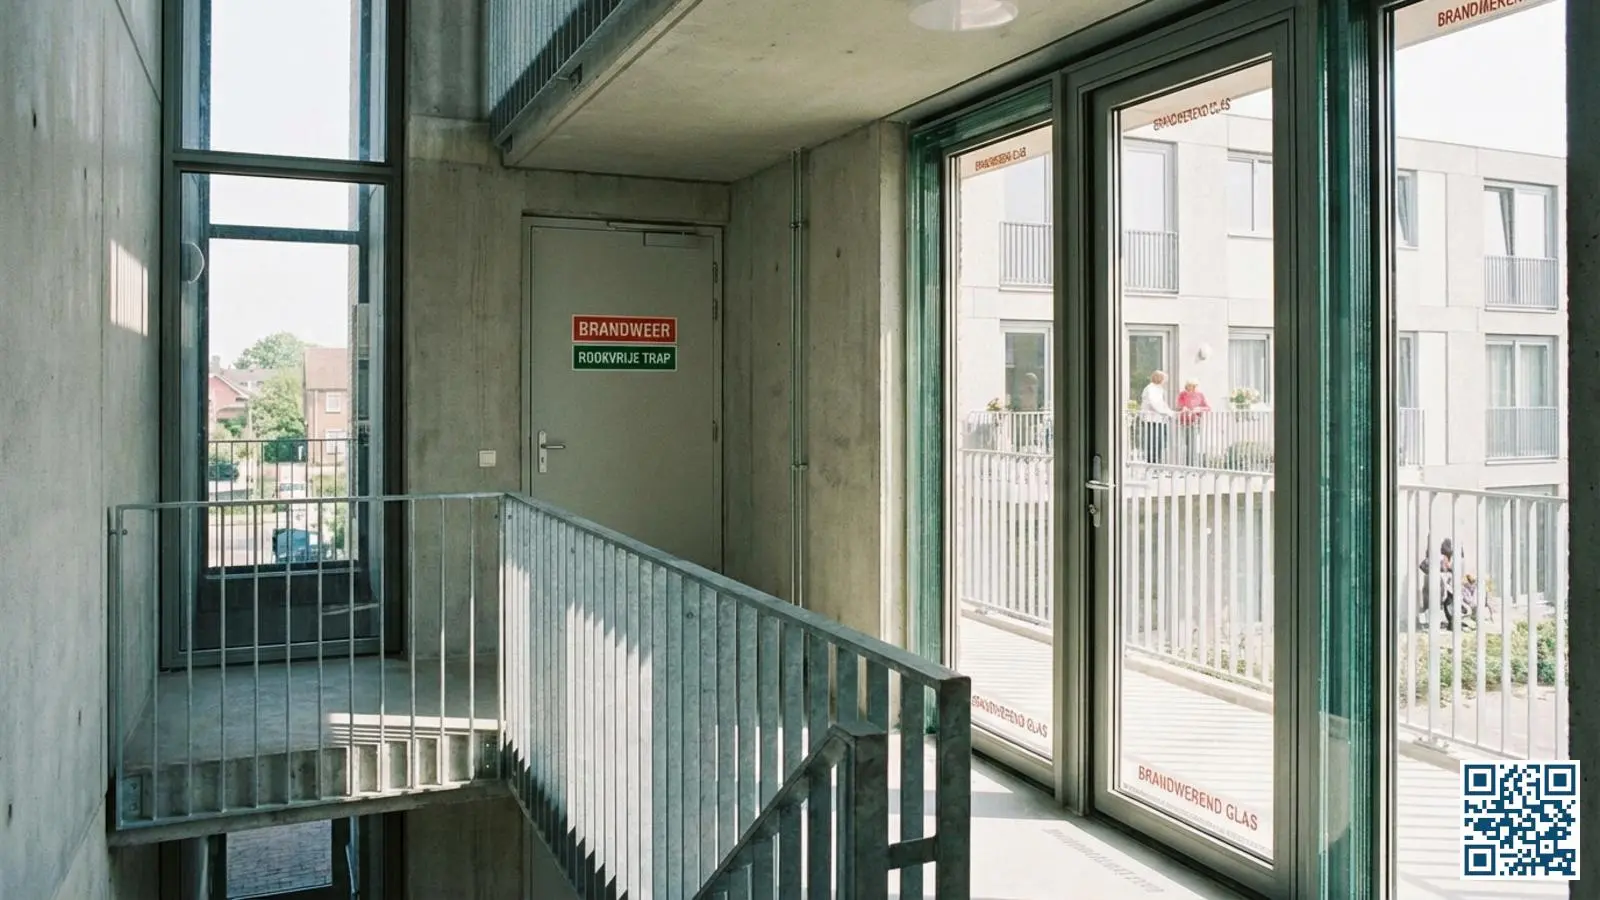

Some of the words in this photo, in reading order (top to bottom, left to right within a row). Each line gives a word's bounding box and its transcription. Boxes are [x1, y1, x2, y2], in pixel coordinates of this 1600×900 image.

[579, 321, 670, 337] BRANDWEER
[578, 351, 640, 364] ROOKVRIJE
[642, 352, 671, 364] TRAP
[1138, 765, 1222, 814] BRANDWEREND
[1226, 803, 1258, 831] GLAS
